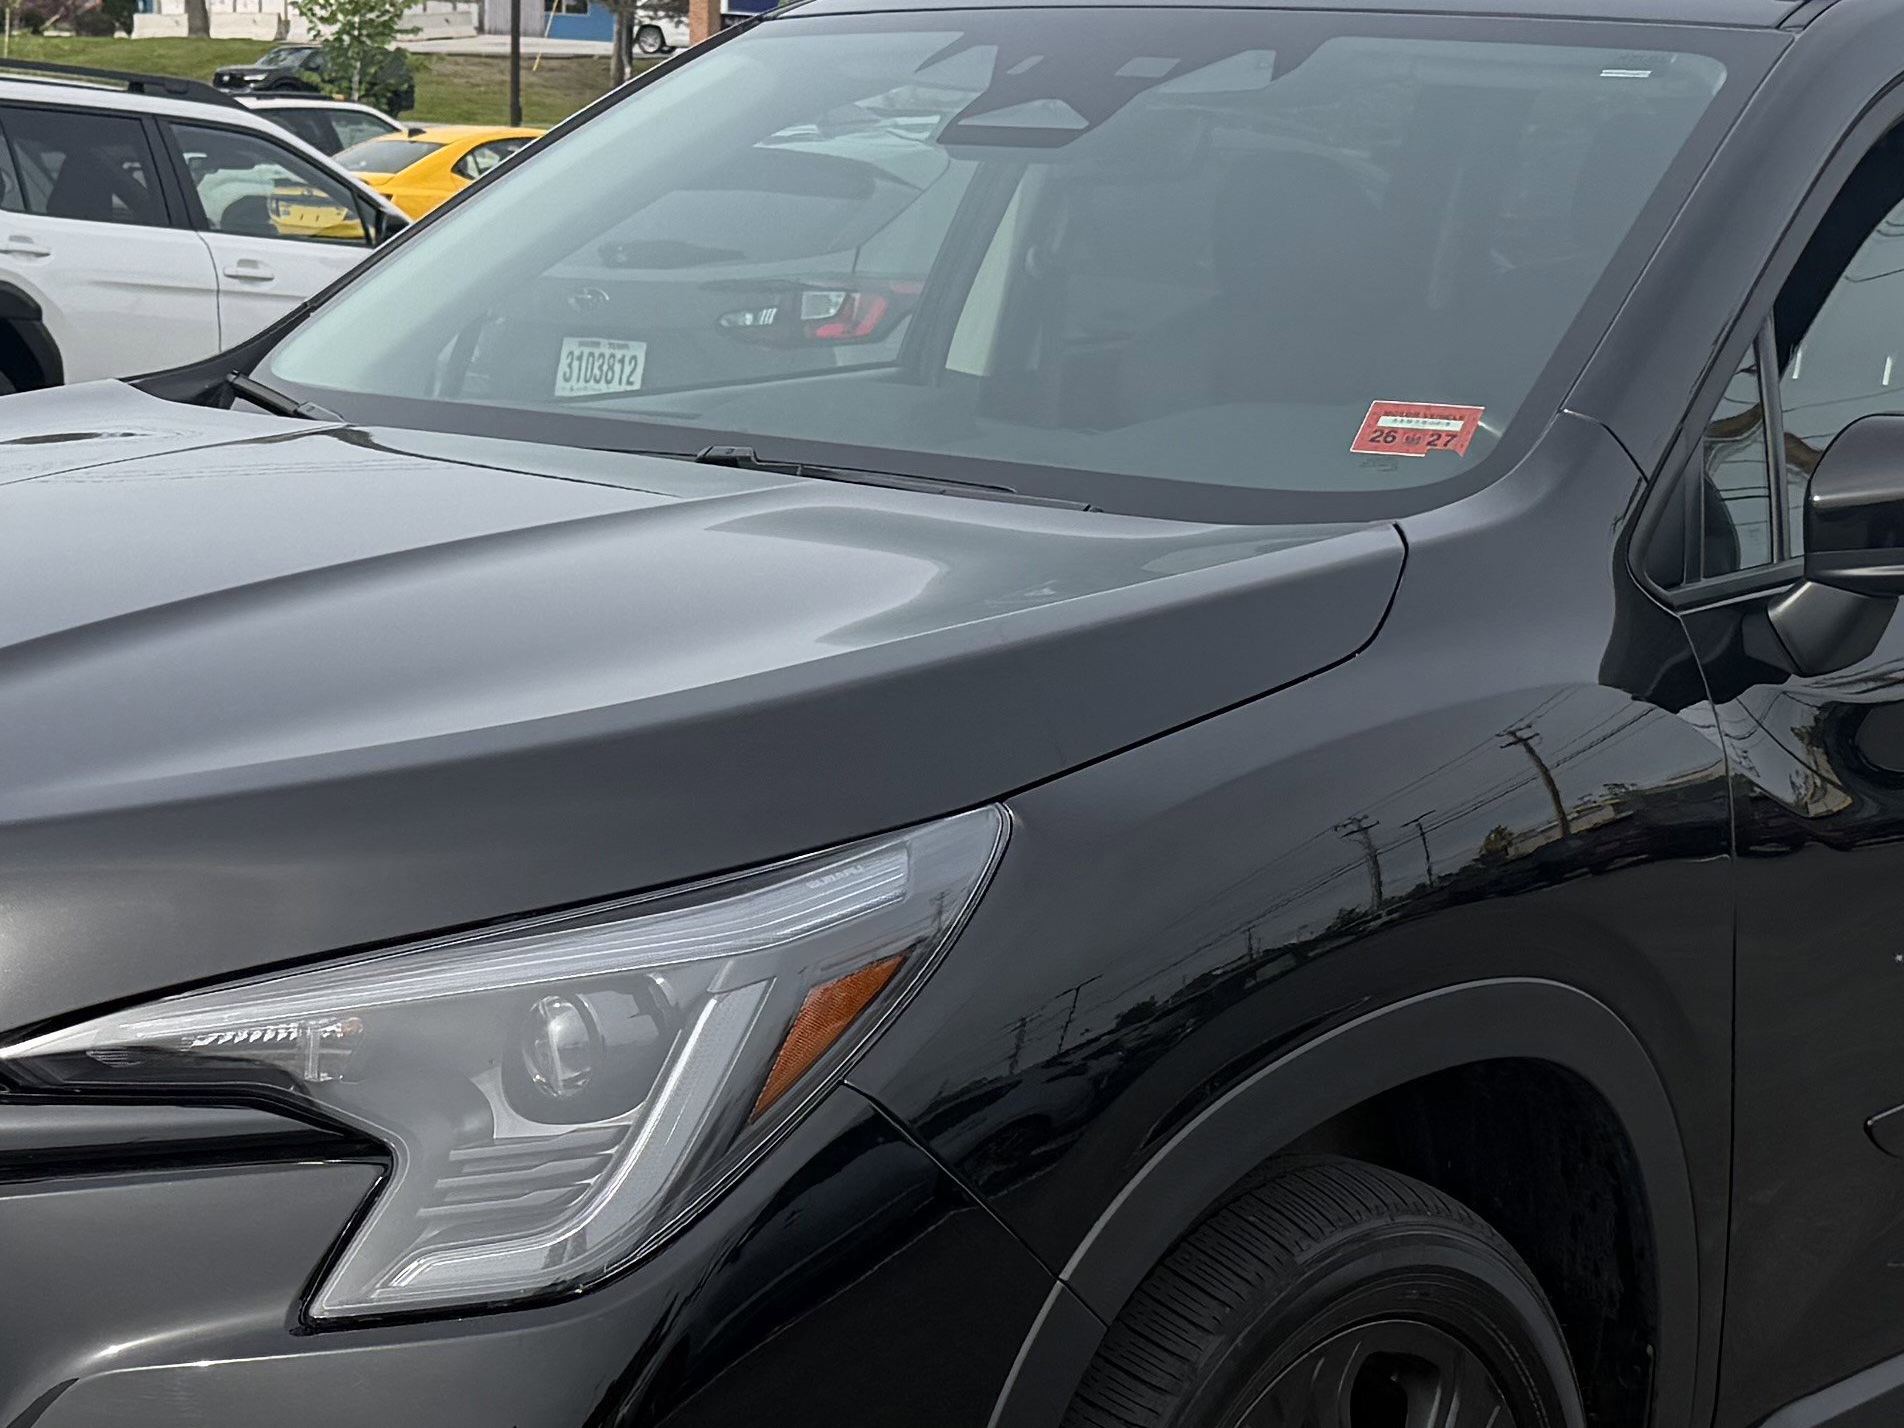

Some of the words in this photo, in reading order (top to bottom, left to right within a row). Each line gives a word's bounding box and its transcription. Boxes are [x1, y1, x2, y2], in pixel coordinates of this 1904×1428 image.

[562, 350, 639, 387] 3103812
[1368, 429, 1398, 444] 26
[1426, 432, 1458, 448] 27
